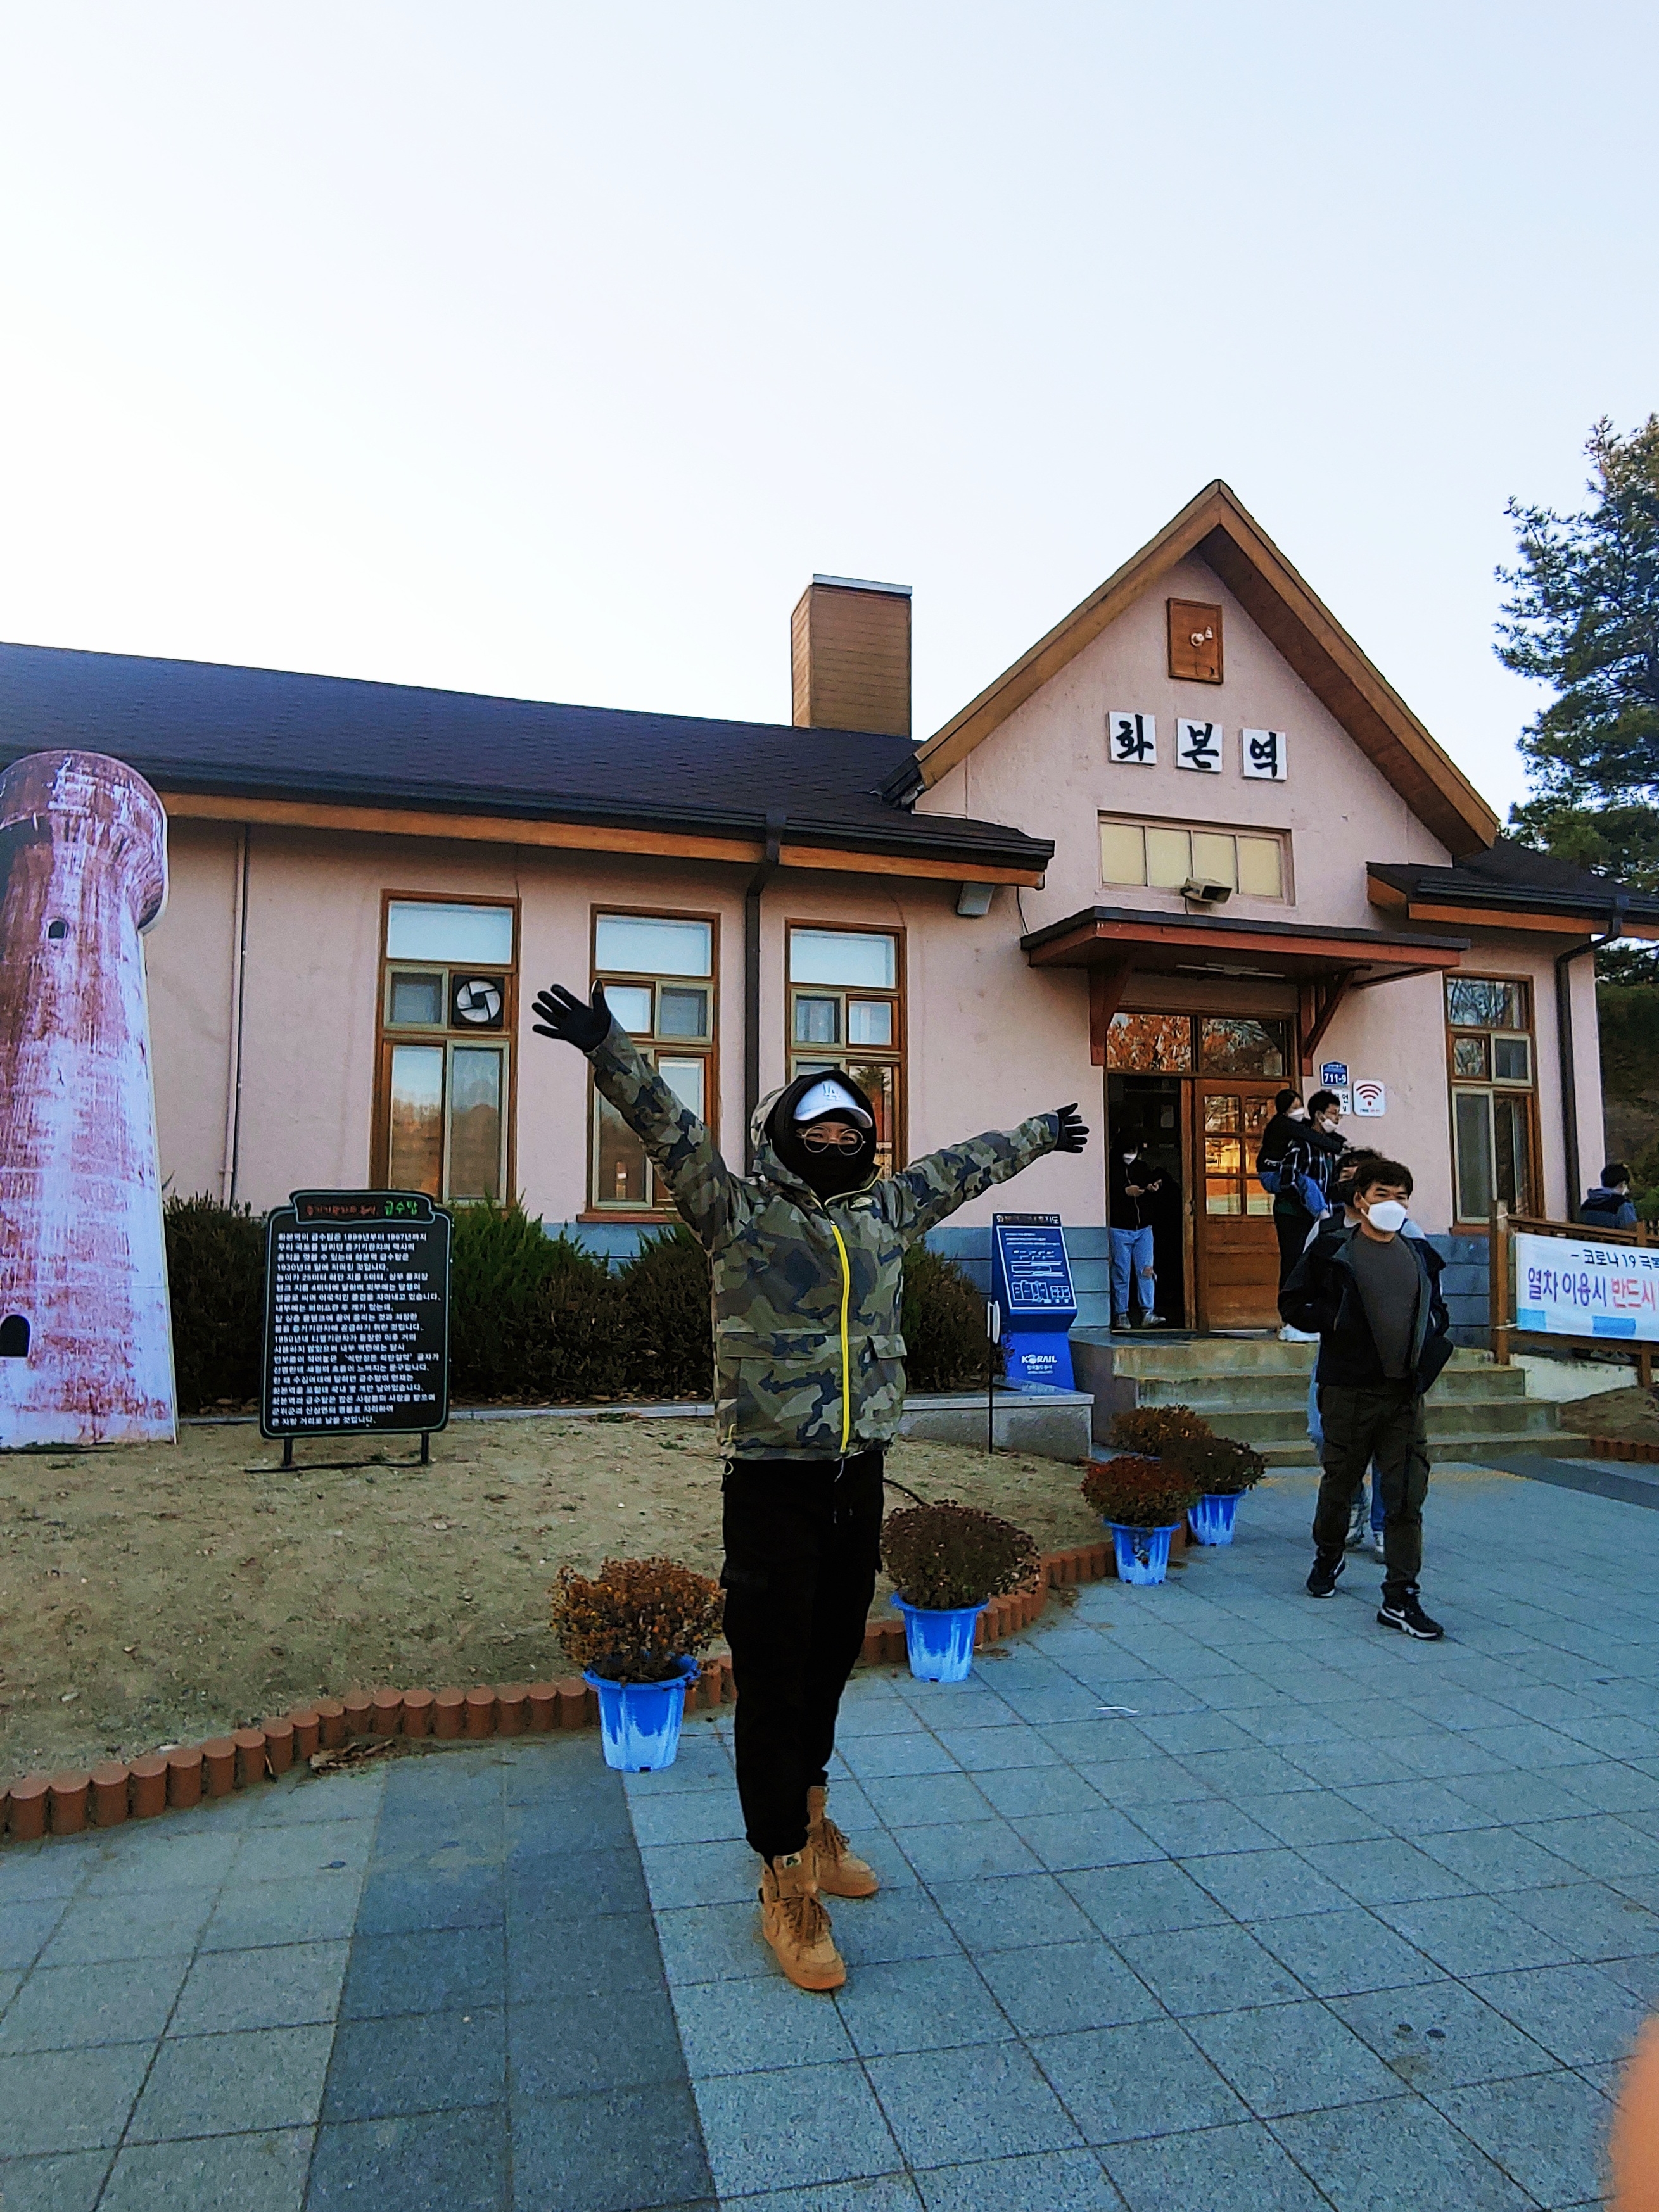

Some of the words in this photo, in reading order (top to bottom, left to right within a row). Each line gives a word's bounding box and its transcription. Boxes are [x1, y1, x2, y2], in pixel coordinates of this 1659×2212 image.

[1116, 714, 1278, 778] 화본역
[1324, 1073, 1347, 1084] 711-9
[822, 1081, 841, 1101] LA
[1582, 1249, 1636, 1268] 코로나19
[1528, 1267, 1558, 1303] 열차
[1562, 1272, 1607, 1307] 이용시
[1611, 1277, 1656, 1311] 반드시
[1022, 1354, 1057, 1364] KORAIL
